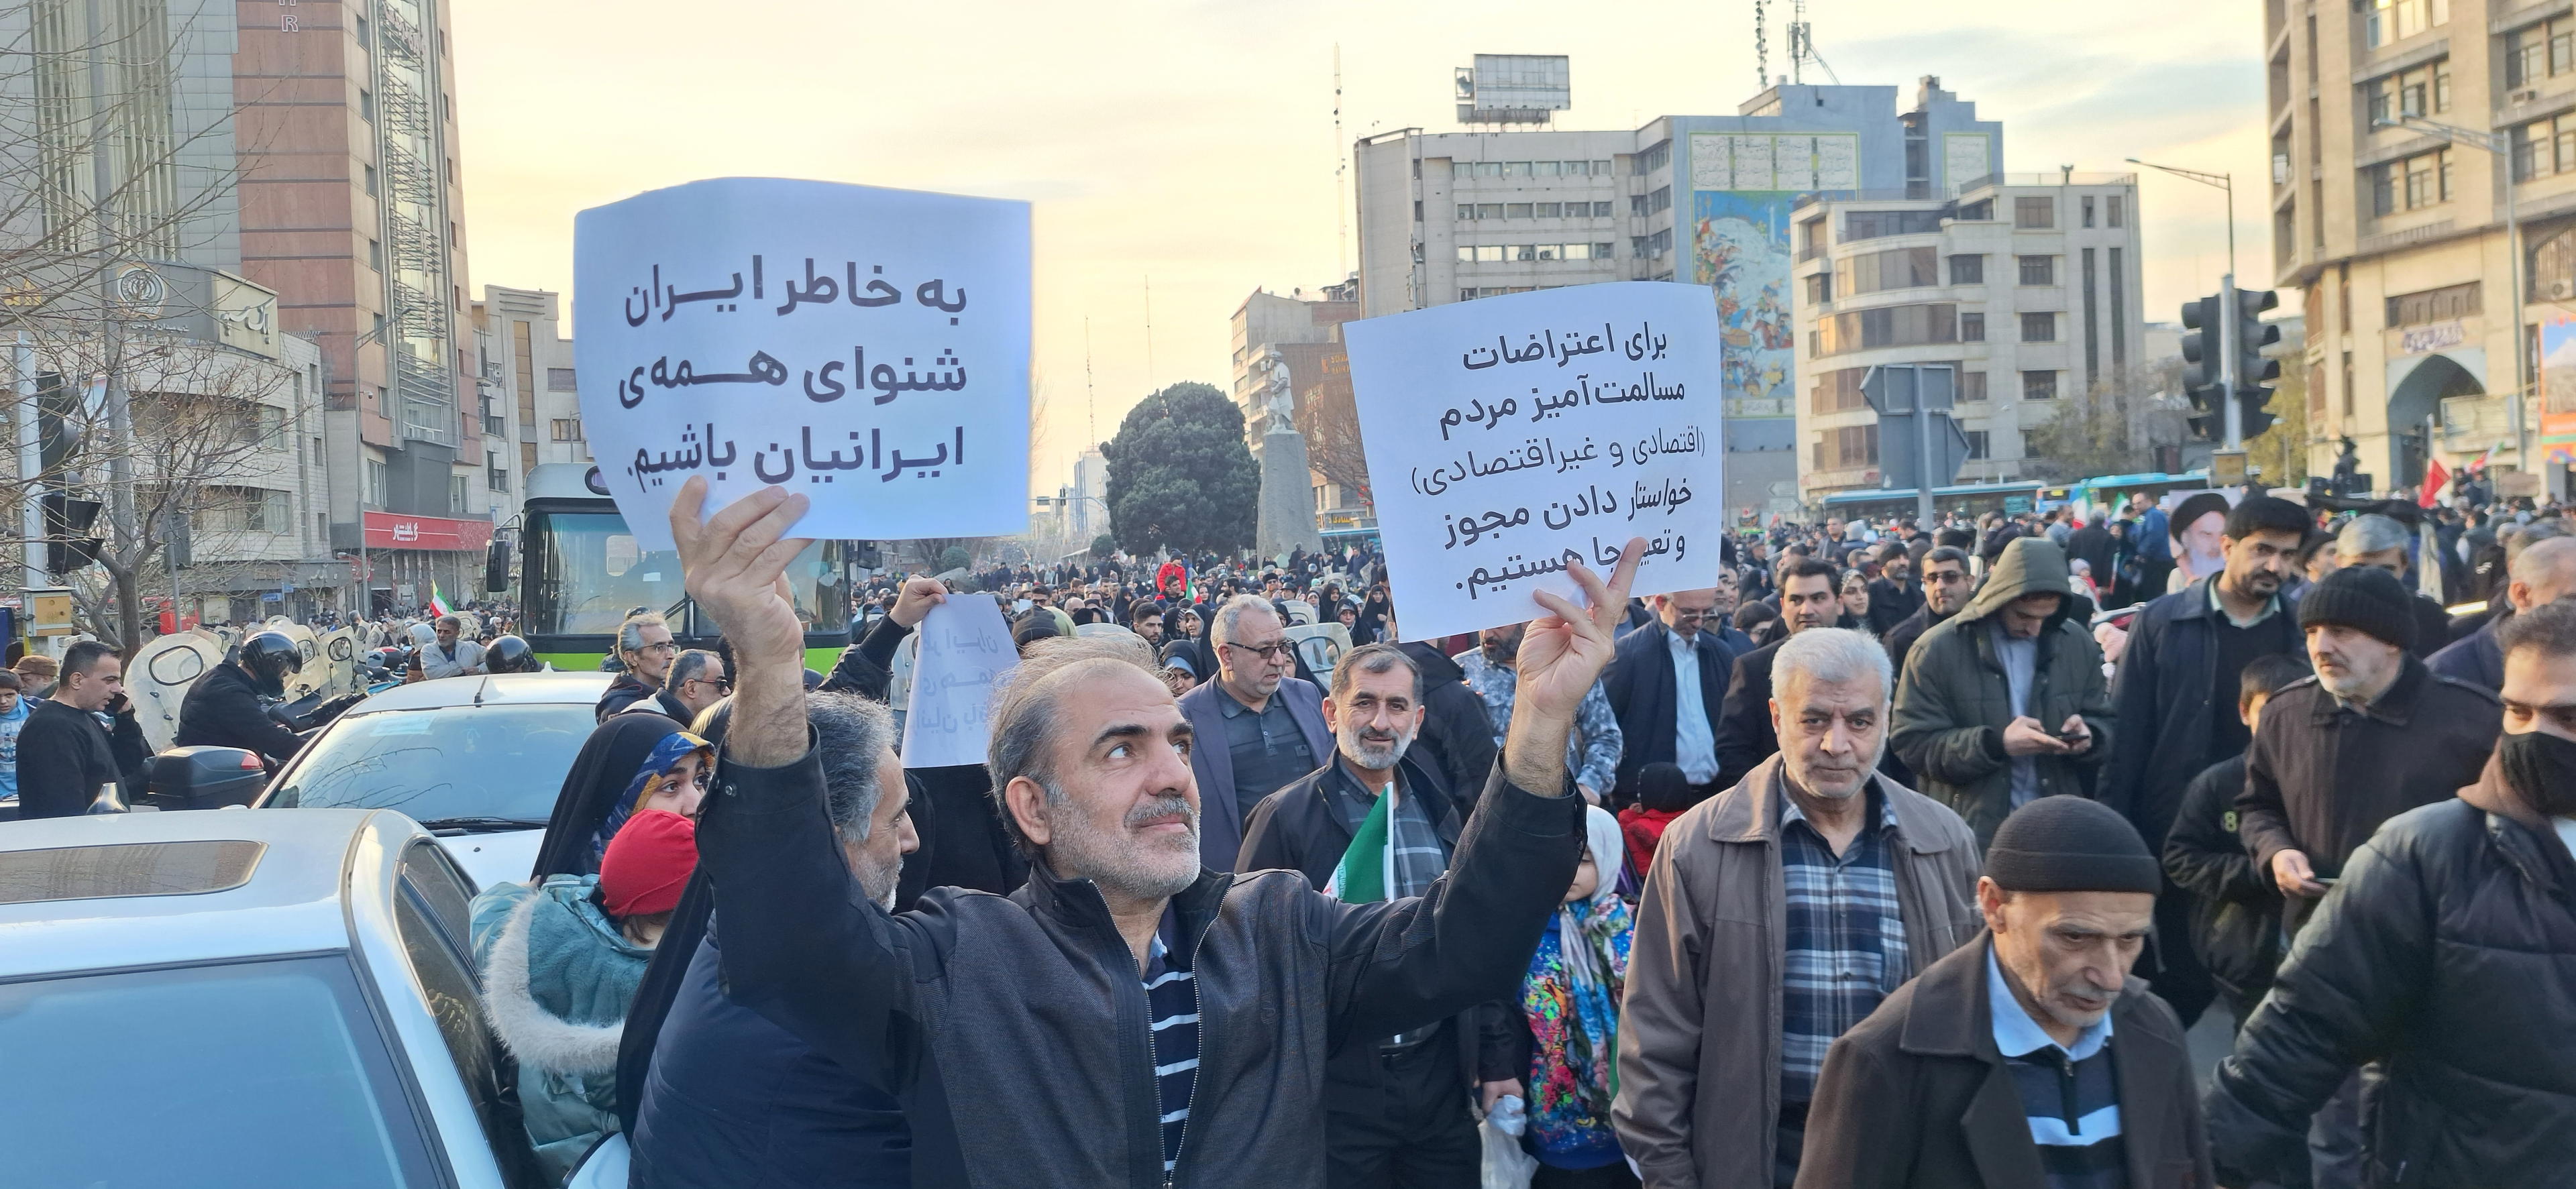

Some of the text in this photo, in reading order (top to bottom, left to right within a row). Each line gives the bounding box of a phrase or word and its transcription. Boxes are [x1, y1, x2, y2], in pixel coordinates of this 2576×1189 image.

[625, 255, 967, 327] به خاطر ایران
[1463, 321, 1667, 370] برای اعتراضات
[804, 346, 967, 406] شنوای
[1440, 397, 1517, 441] مردم
[627, 422, 963, 494] ایرانیان باشیم.
[1609, 442, 1624, 468] و
[1632, 425, 1705, 465] (اقتصادی
[1444, 477, 1692, 550] خواستار دادن مجوز
[1593, 536, 1621, 573] جا
[1676, 535, 1685, 563] و
[1456, 548, 1585, 600] هستیم.
